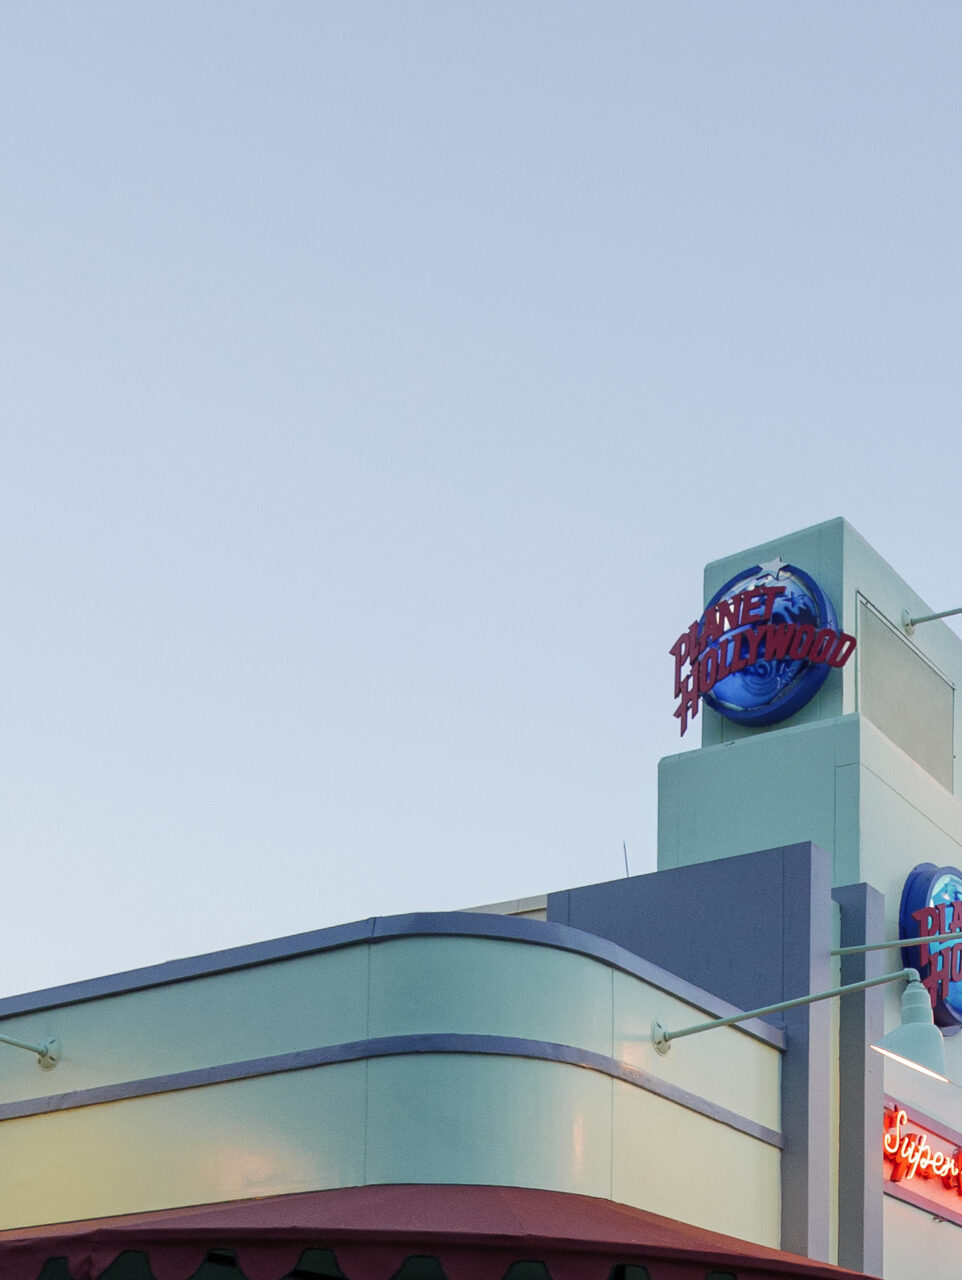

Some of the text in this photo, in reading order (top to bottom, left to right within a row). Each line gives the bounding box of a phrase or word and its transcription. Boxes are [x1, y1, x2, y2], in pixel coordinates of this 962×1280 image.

[668, 585, 787, 700] PLANET
[672, 622, 858, 738] HOLLYWOOD
[883, 1106, 959, 1181] Super
